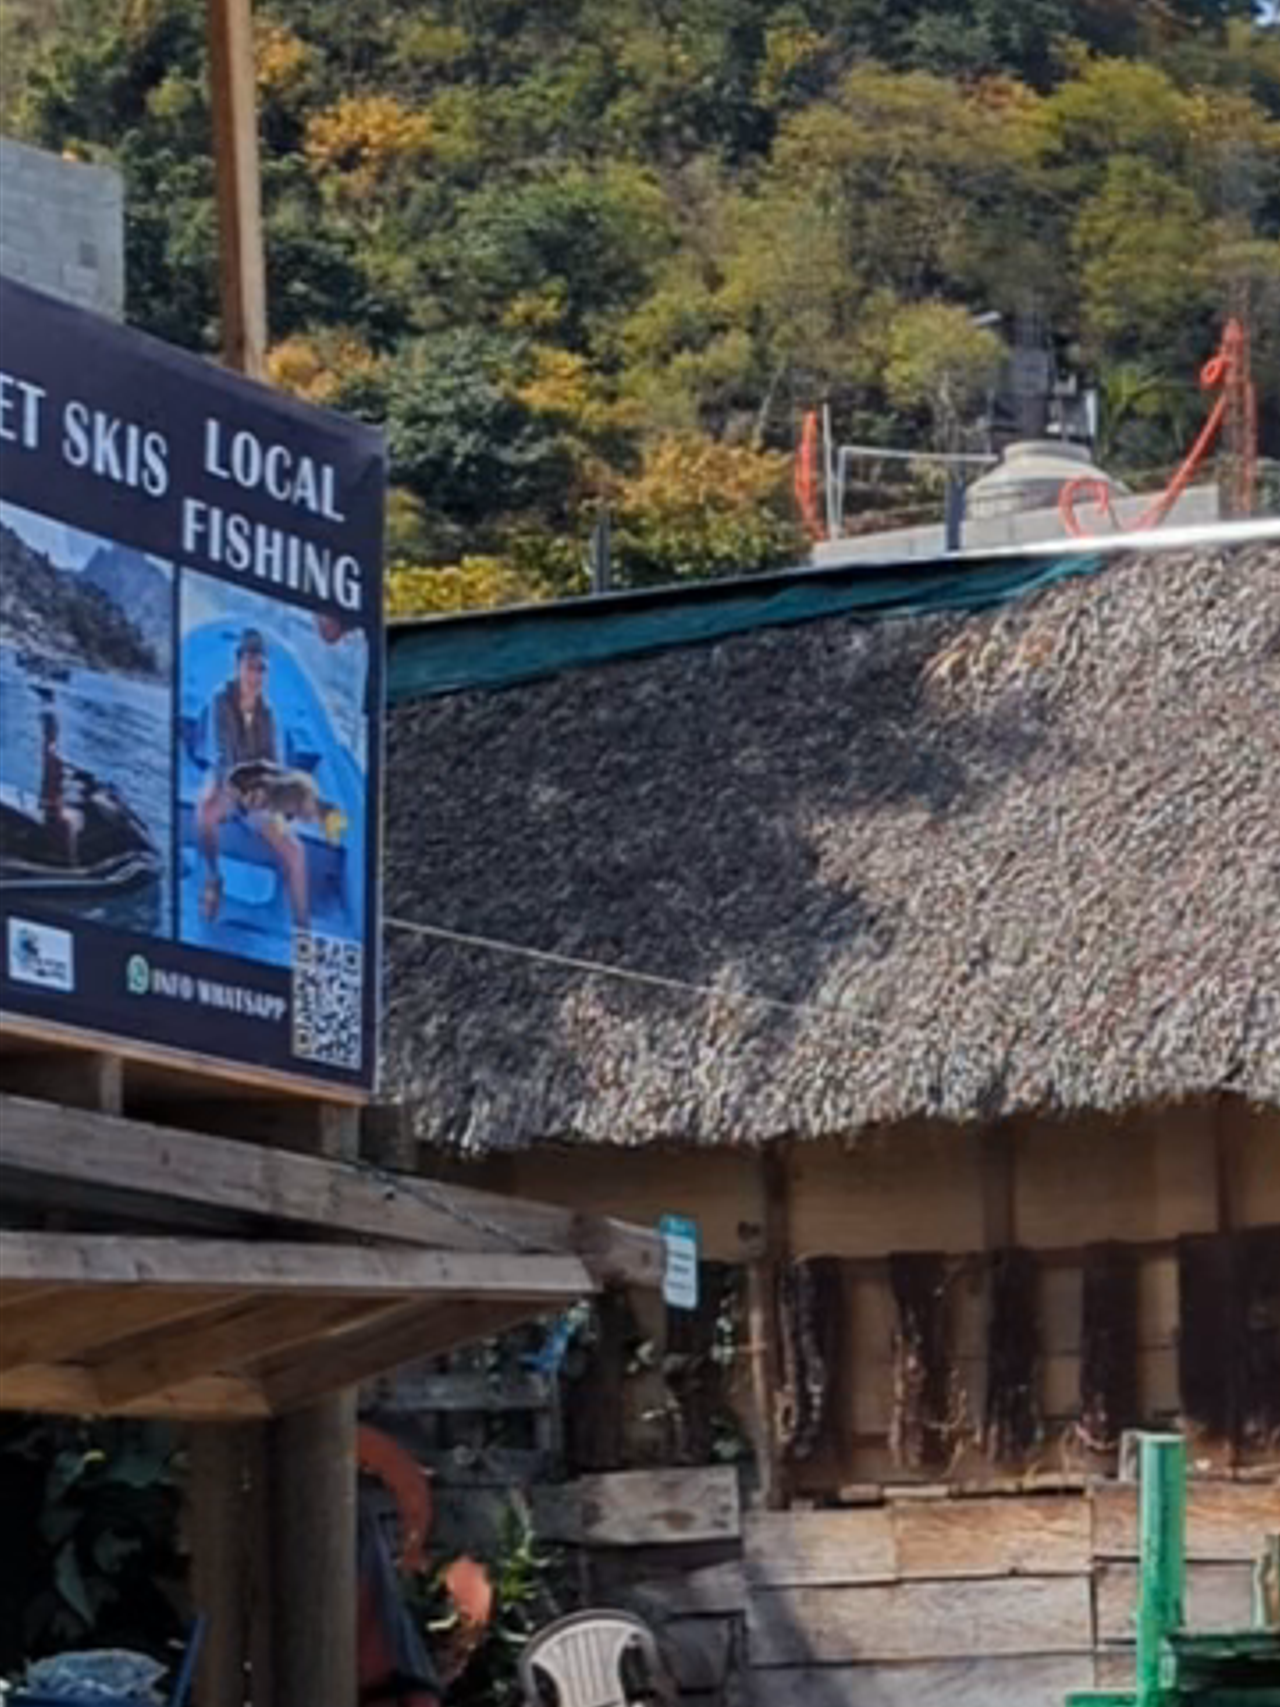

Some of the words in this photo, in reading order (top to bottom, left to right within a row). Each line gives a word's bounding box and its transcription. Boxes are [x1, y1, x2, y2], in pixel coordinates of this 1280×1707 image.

[62, 401, 169, 497] SKIS
[205, 418, 345, 522] LOCAL
[182, 497, 362, 611] FISHING
[153, 969, 193, 999] INFO
[199, 978, 286, 1021] WHATSAPP
